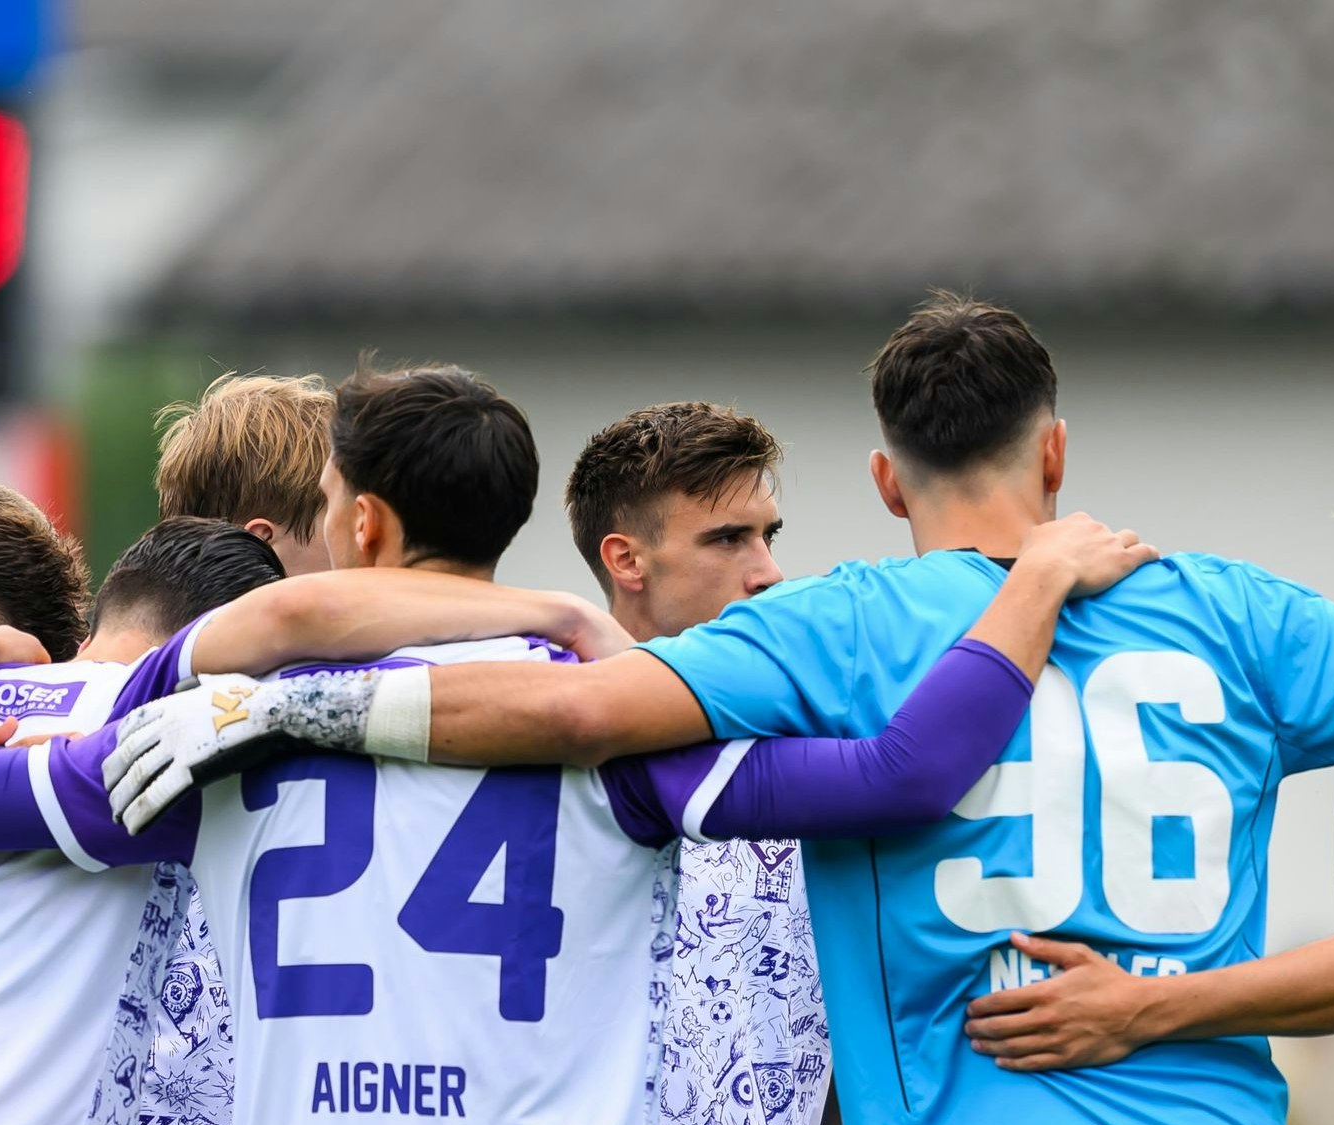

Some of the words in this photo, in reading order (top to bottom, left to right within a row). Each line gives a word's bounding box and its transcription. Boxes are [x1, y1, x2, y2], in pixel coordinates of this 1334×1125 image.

[240, 755, 565, 1023] 24
[933, 650, 1234, 934] 96
[311, 1061, 467, 1118] AIGNER
